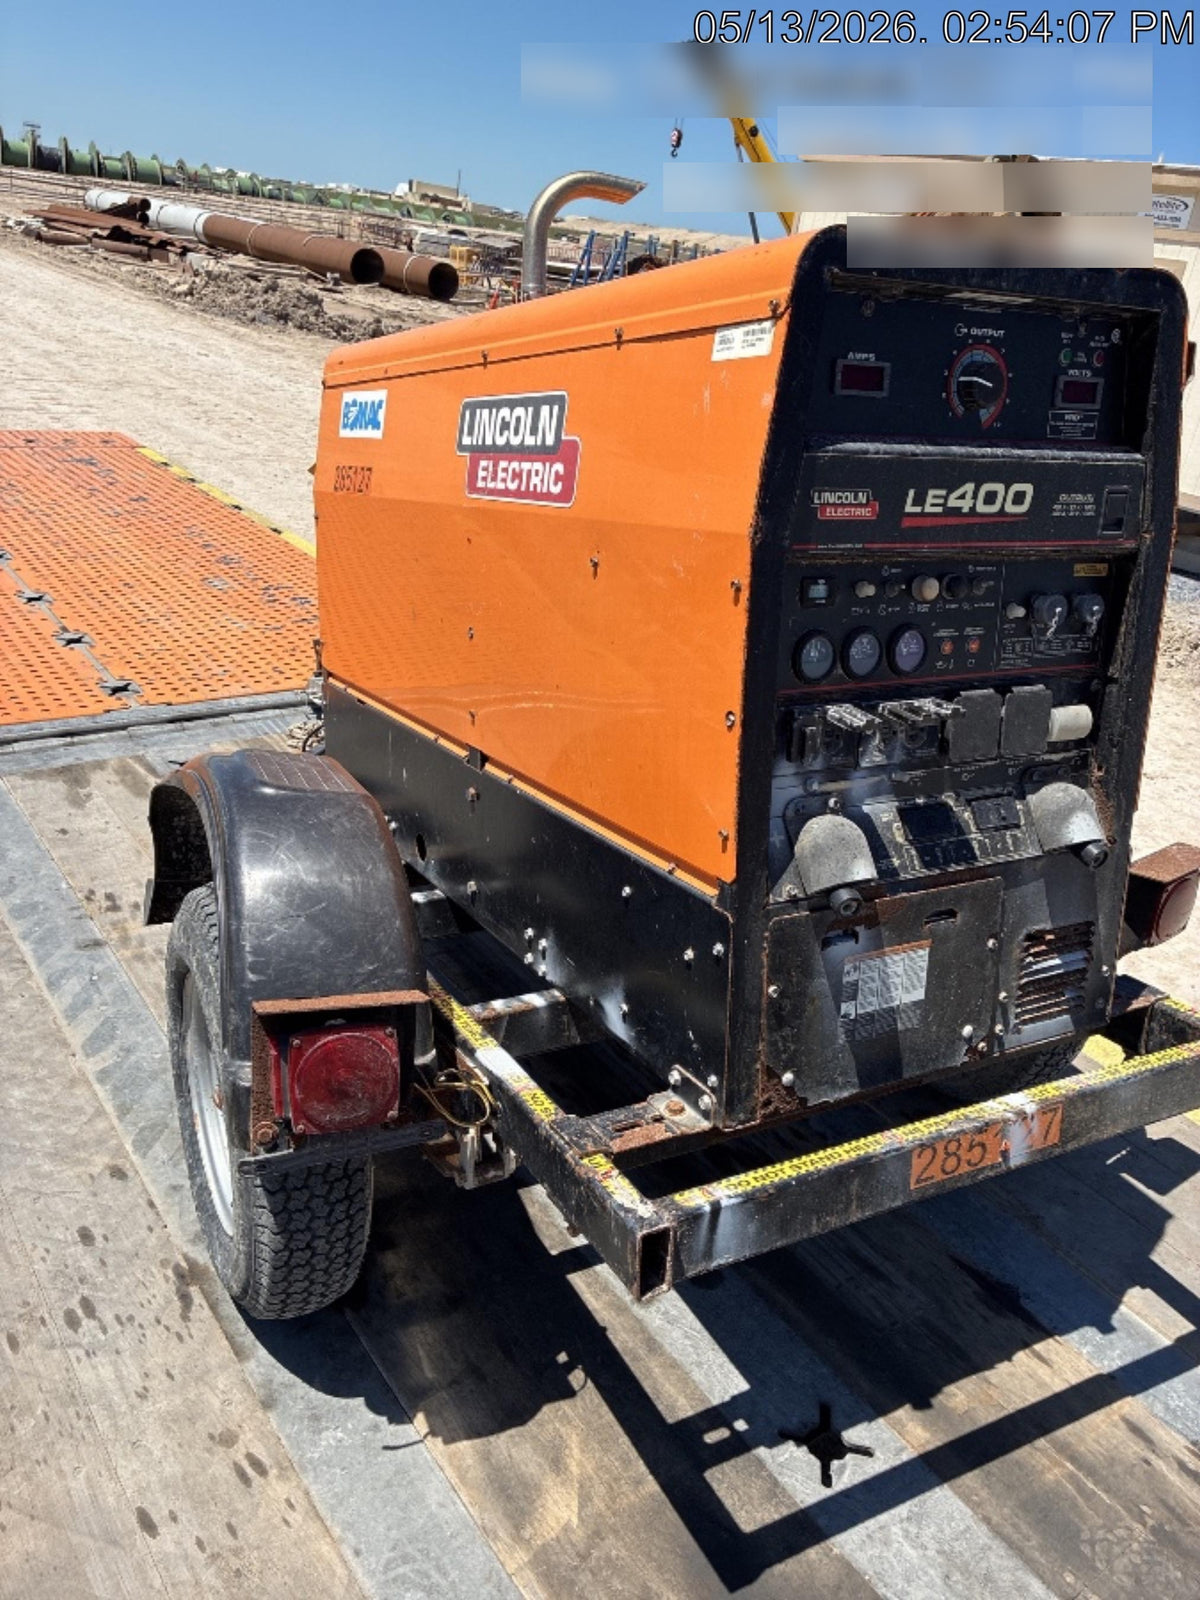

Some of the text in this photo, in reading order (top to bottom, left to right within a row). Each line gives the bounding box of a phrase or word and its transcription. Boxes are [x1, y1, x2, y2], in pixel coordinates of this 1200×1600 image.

[970, 326, 1006, 338] OUTPUT
[461, 404, 559, 447] LINCOLN
[476, 459, 565, 495] ELECTRIC
[813, 491, 868, 504] LINCOLN
[825, 507, 873, 517] ELECTRIC
[904, 482, 1034, 513] LE400
[753, 1167, 787, 1183] NOT
[792, 1150, 843, 1174] STAND
